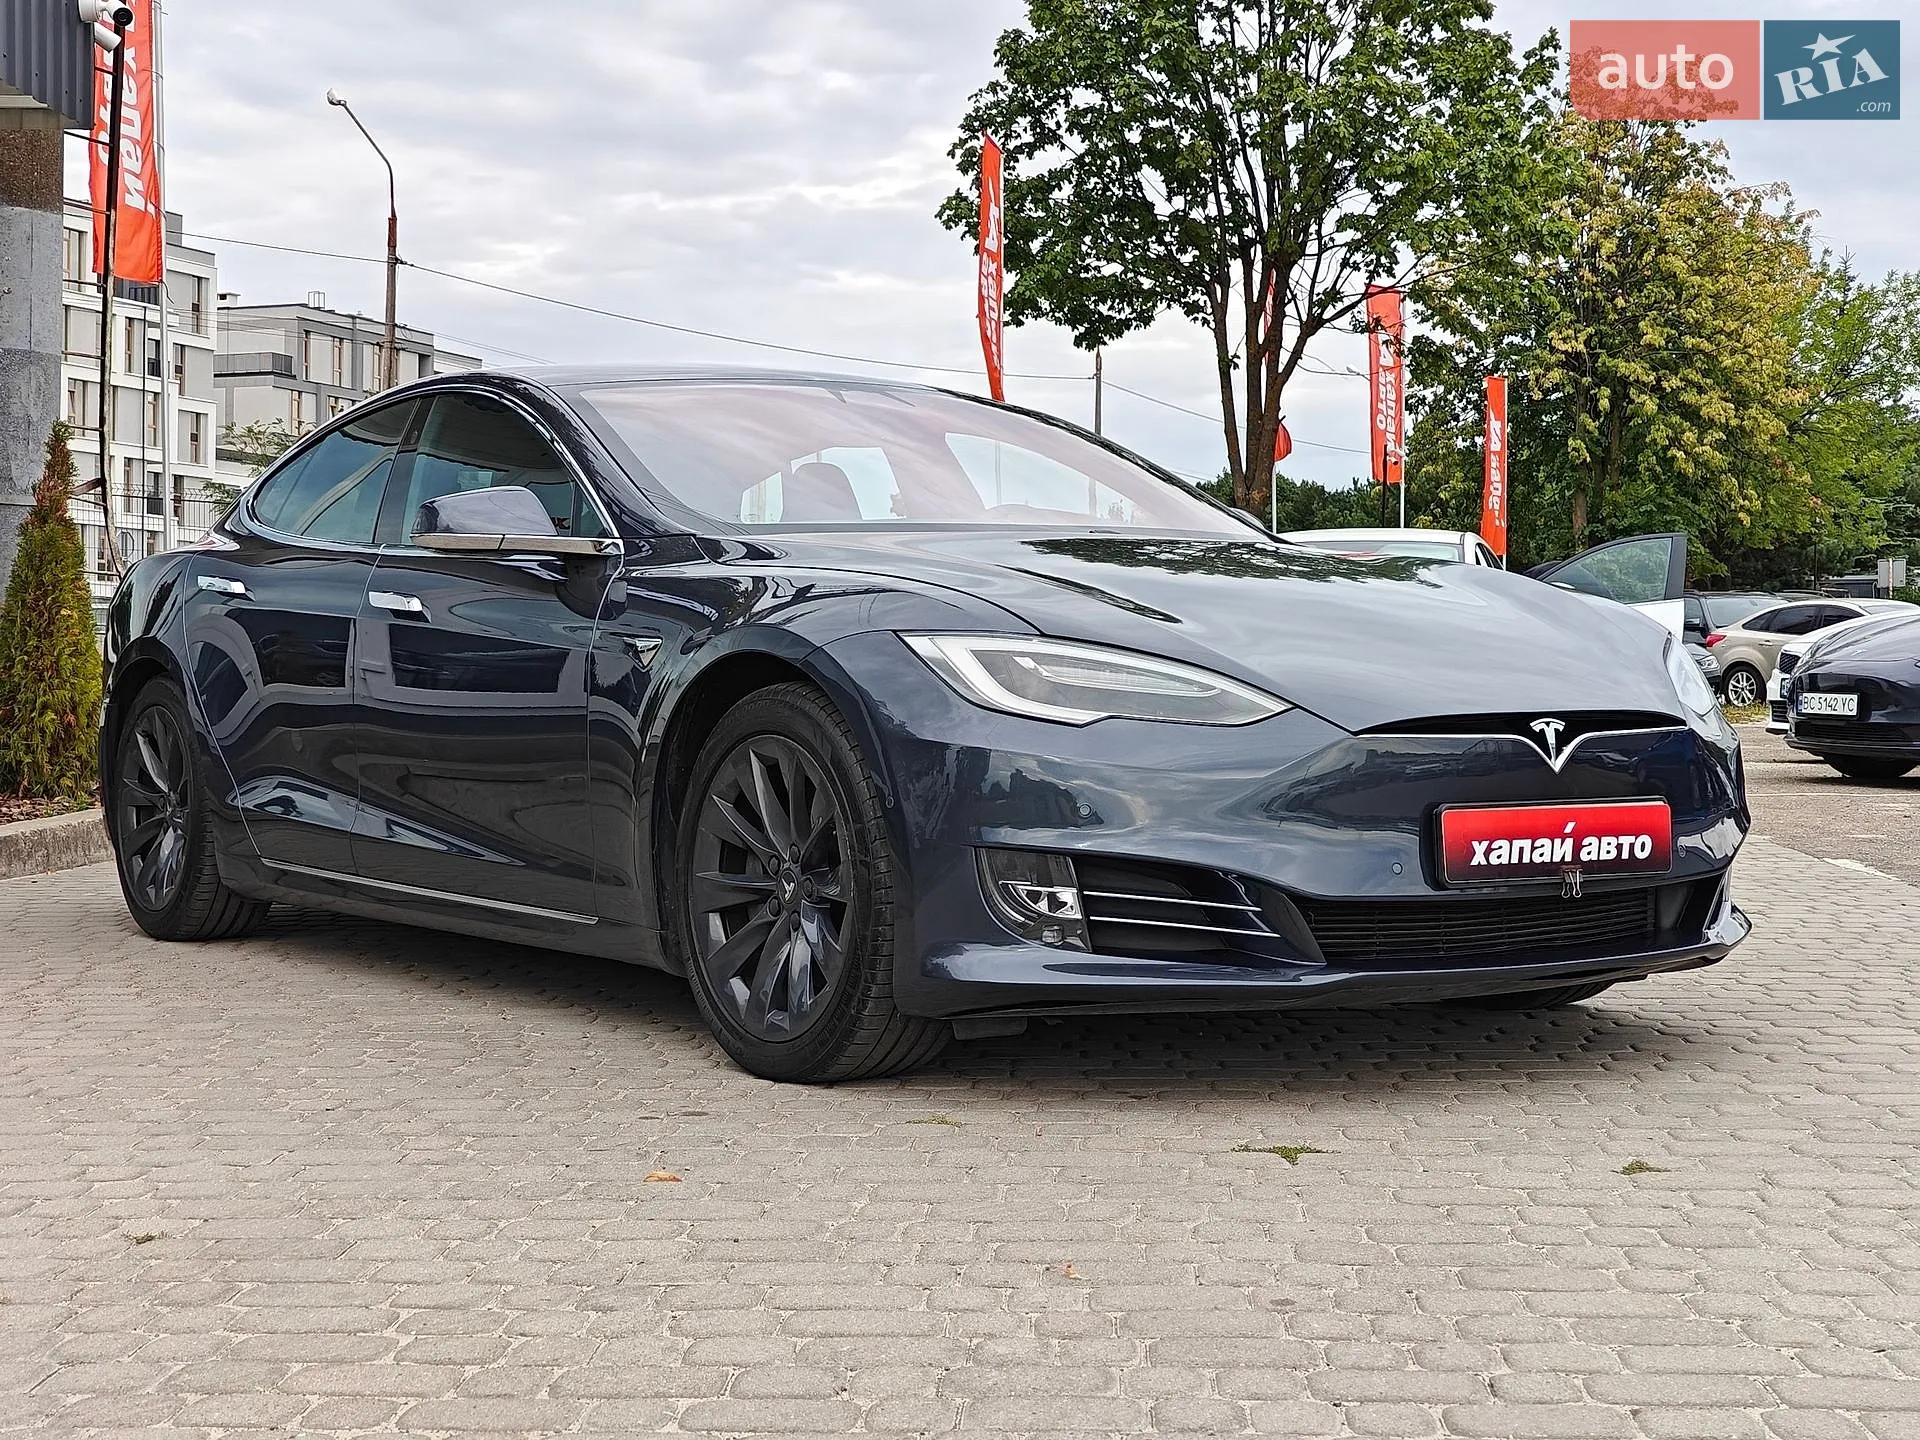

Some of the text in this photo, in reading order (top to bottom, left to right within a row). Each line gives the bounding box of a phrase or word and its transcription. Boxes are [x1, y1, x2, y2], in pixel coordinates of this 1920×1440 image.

[1803, 696, 1855, 712] BC 5142 YC
[1470, 821, 1653, 866] хапай авто
